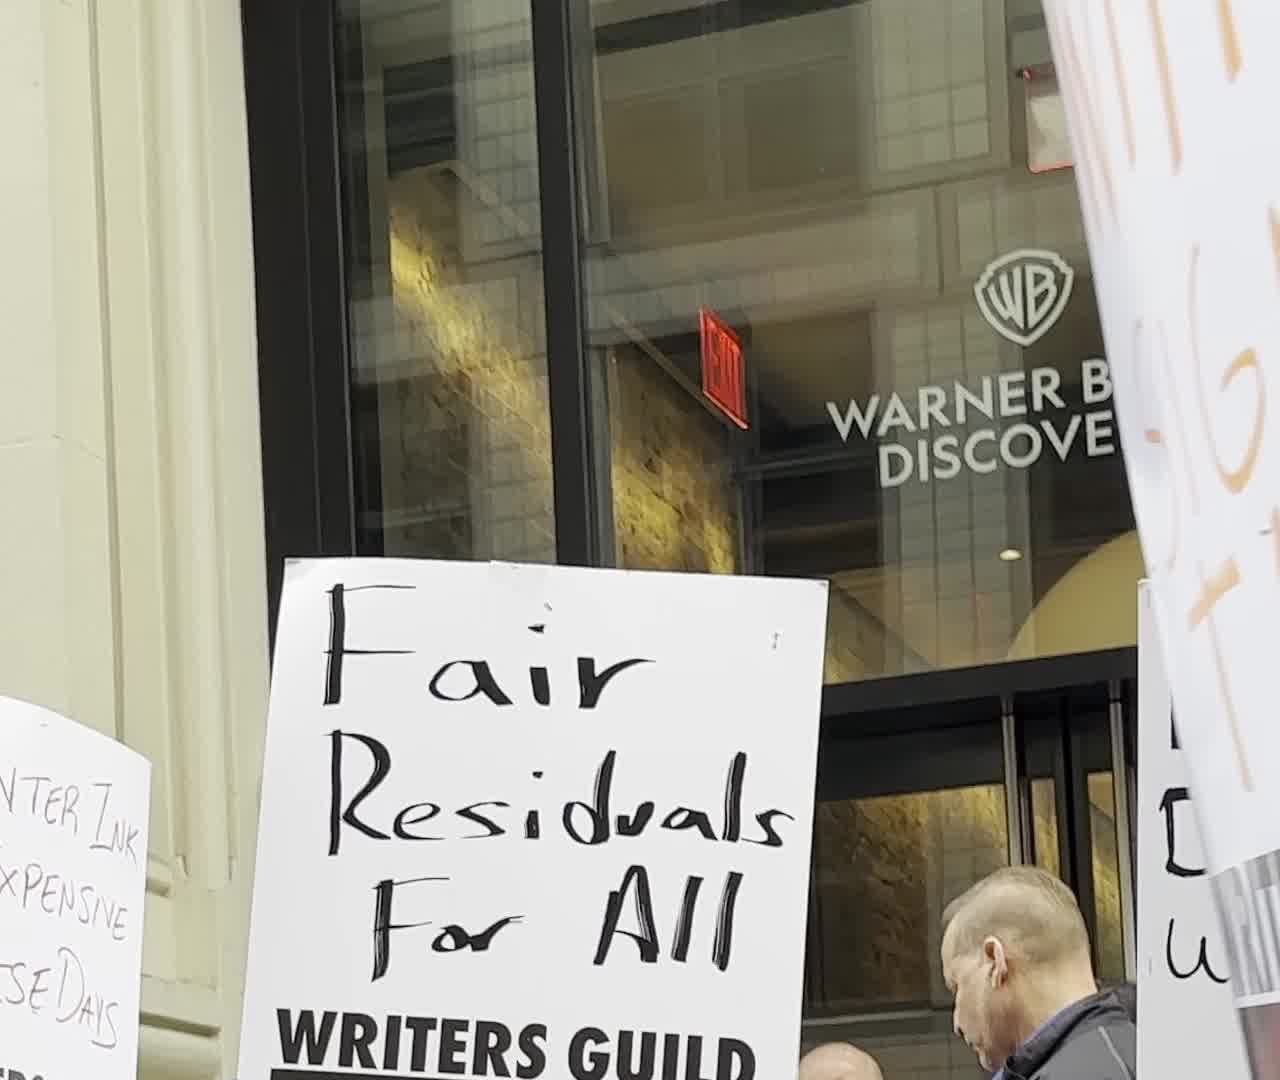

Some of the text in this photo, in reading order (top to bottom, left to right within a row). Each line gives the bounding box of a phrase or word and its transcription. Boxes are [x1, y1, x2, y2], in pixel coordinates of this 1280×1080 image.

[826, 366, 1066, 443] WARNER
[323, 583, 657, 708] Fair
[372, 864, 744, 982] For All
[276, 1008, 548, 1080] WRITERS
